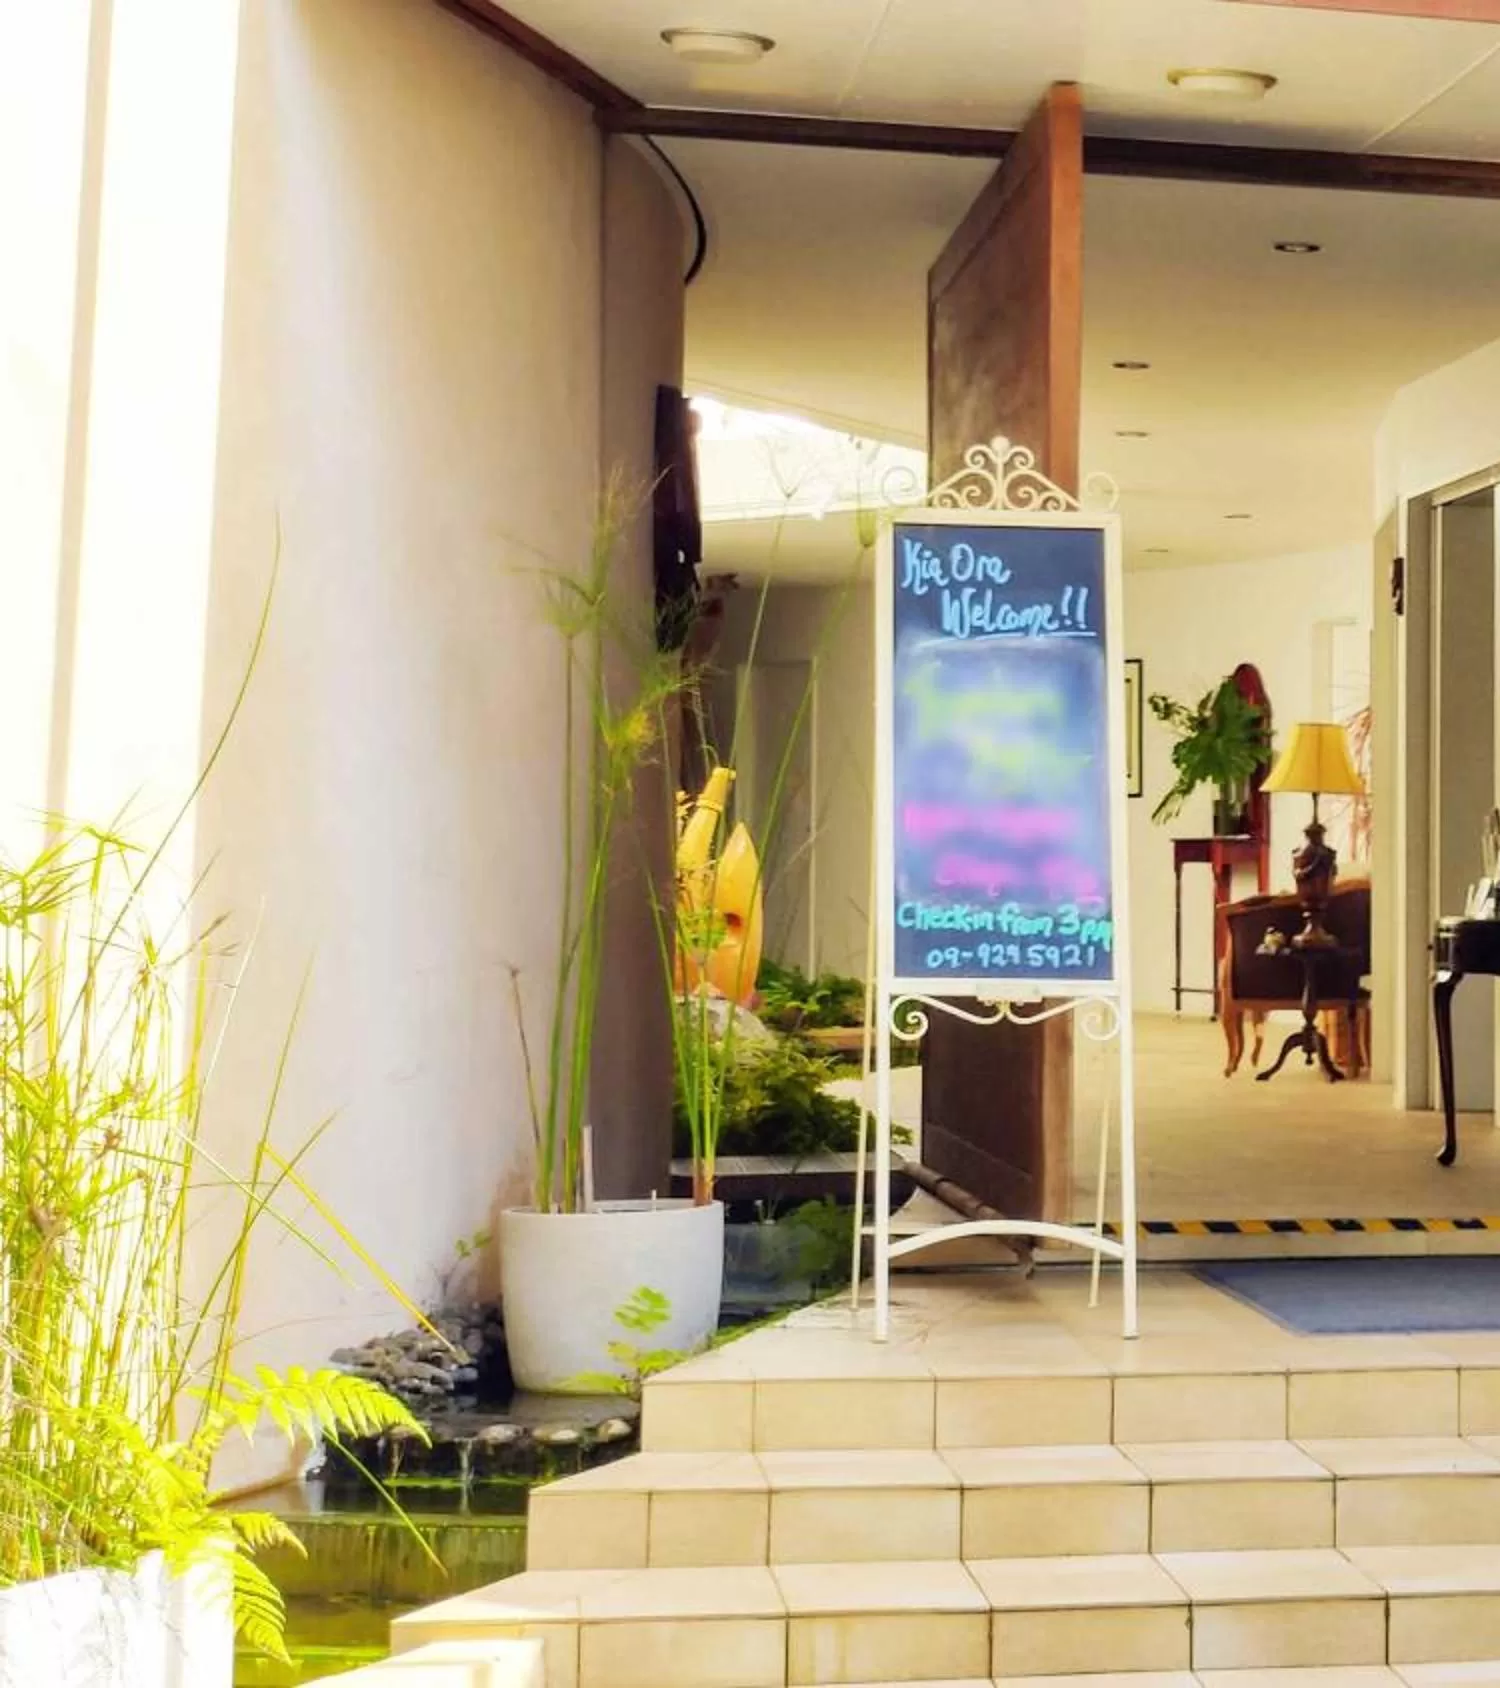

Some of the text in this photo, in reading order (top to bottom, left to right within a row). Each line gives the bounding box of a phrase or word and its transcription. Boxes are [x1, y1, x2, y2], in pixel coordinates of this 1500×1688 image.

[901, 538, 1012, 595] Kia Ora
[941, 584, 1088, 639] Welcome!!
[996, 901, 1054, 937] from
[1026, 943, 1095, 968] 5921
